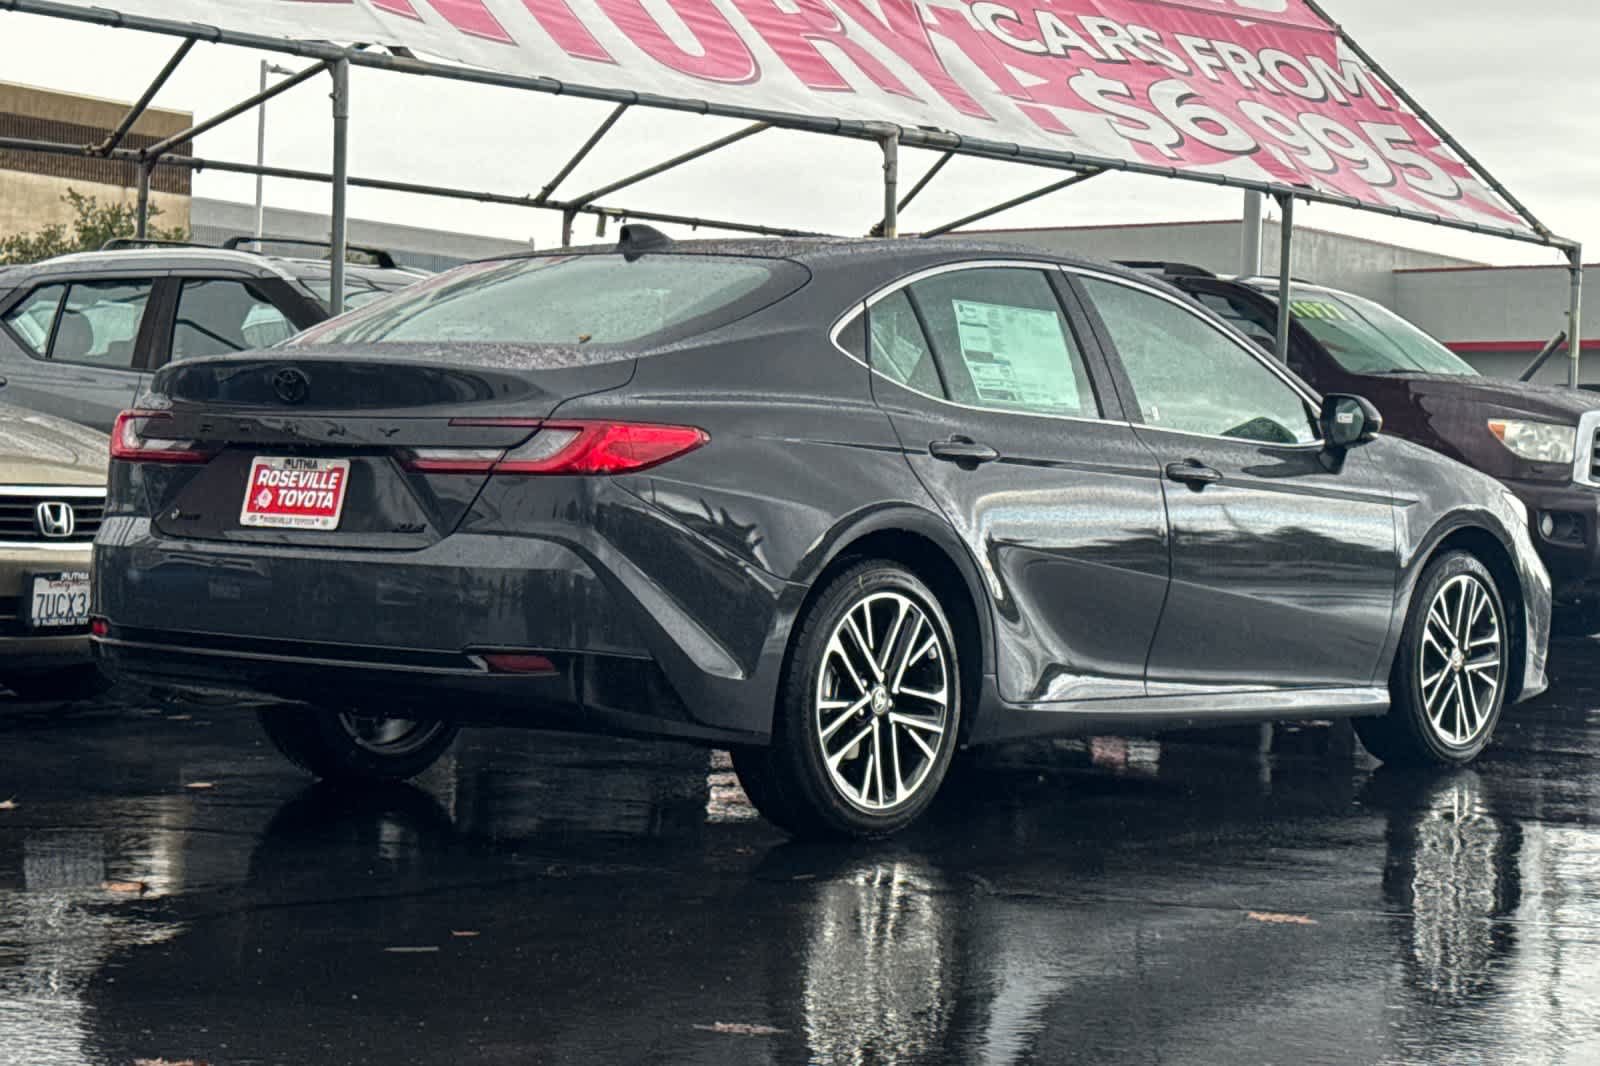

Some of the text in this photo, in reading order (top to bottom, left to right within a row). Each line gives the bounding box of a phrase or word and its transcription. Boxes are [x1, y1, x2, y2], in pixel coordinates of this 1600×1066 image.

[970, 1, 1192, 75] CARS
[1174, 33, 1391, 110] FROM
[1067, 68, 1462, 199] $6,995
[257, 469, 340, 489] ROSEVILLE
[277, 490, 334, 509] TOYOTA
